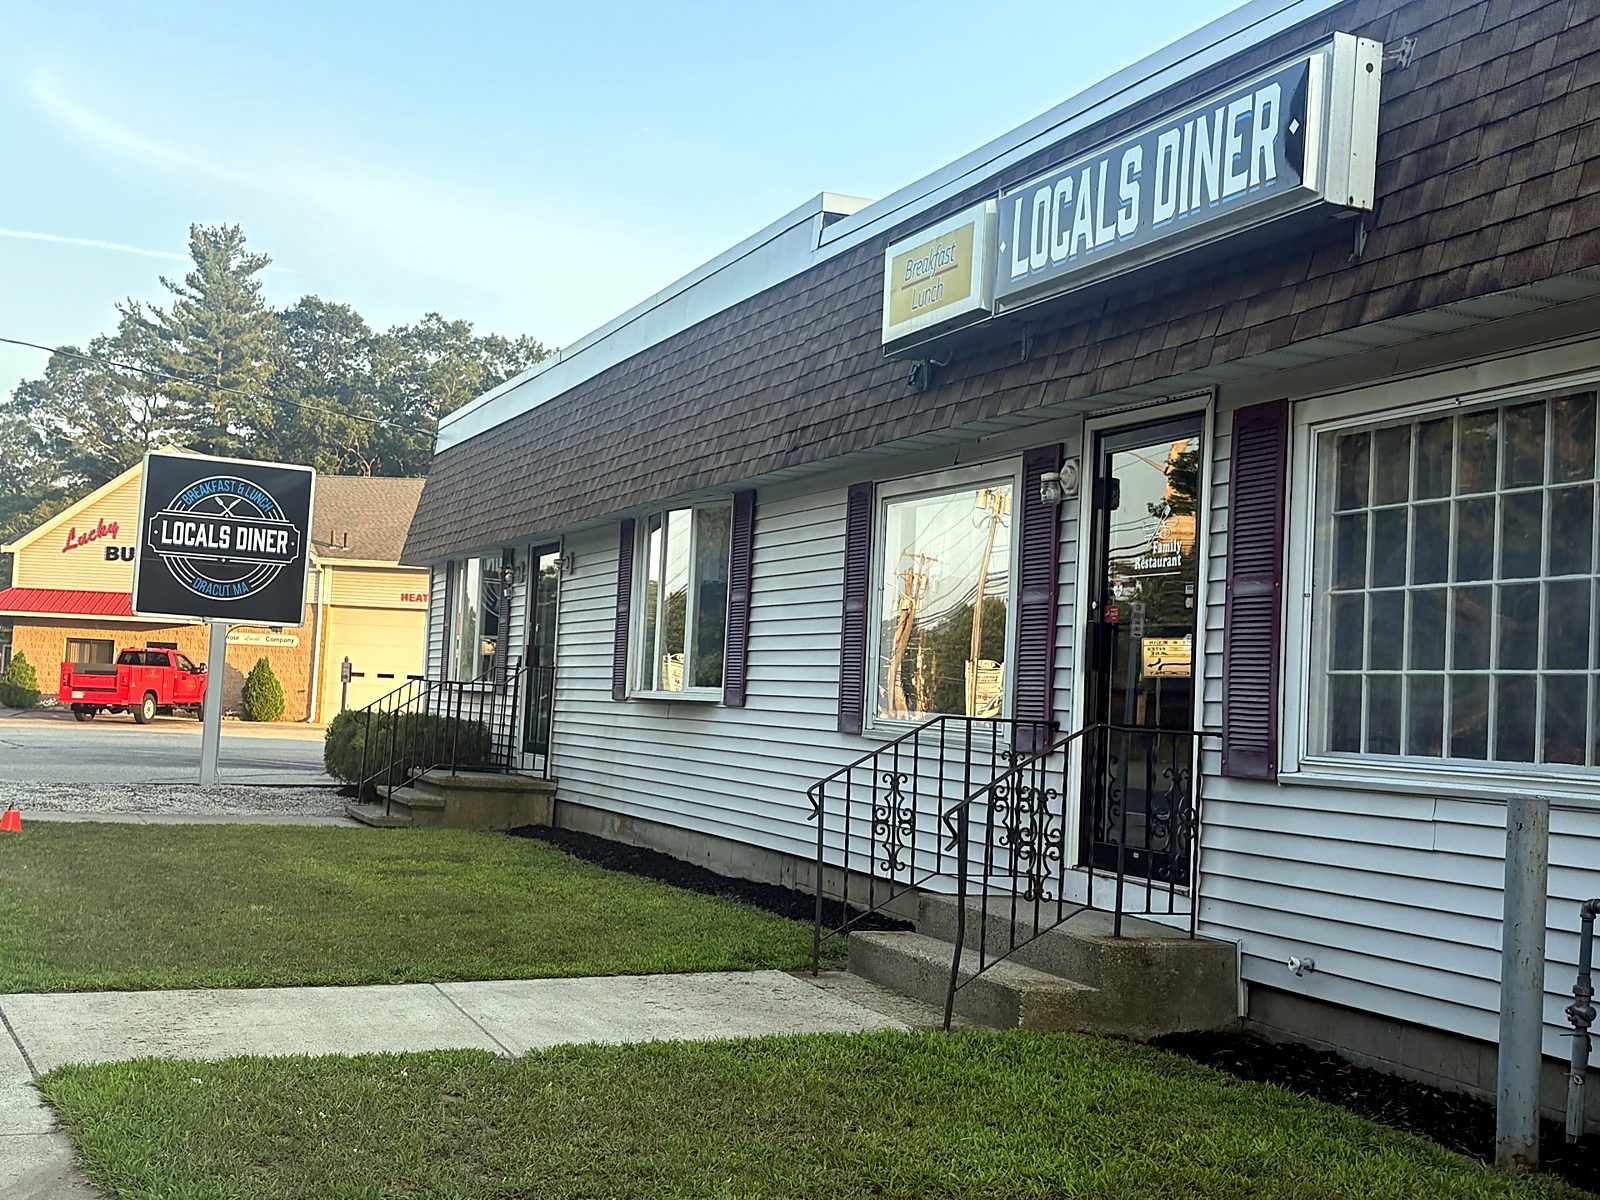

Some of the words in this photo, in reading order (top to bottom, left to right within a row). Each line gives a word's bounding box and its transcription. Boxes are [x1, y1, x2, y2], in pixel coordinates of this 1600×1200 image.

[1010, 144, 1143, 281] LOCALS
[1152, 82, 1282, 228] DINER
[904, 242, 957, 281] Breakfast
[911, 278, 944, 310] Lunch
[182, 480, 236, 506] BREAKFAST
[237, 484, 245, 494] &
[245, 486, 274, 513] LUNCH
[62, 518, 119, 553] Lucky
[161, 520, 231, 549] LOCALS
[236, 526, 289, 554] DINER
[1152, 539, 1182, 554] Family
[105, 546, 135, 562] BU
[1134, 555, 1182, 570] Restaurant
[192, 577, 232, 597] DRACUT
[233, 582, 249, 596] MA
[265, 636, 295, 644] Company
